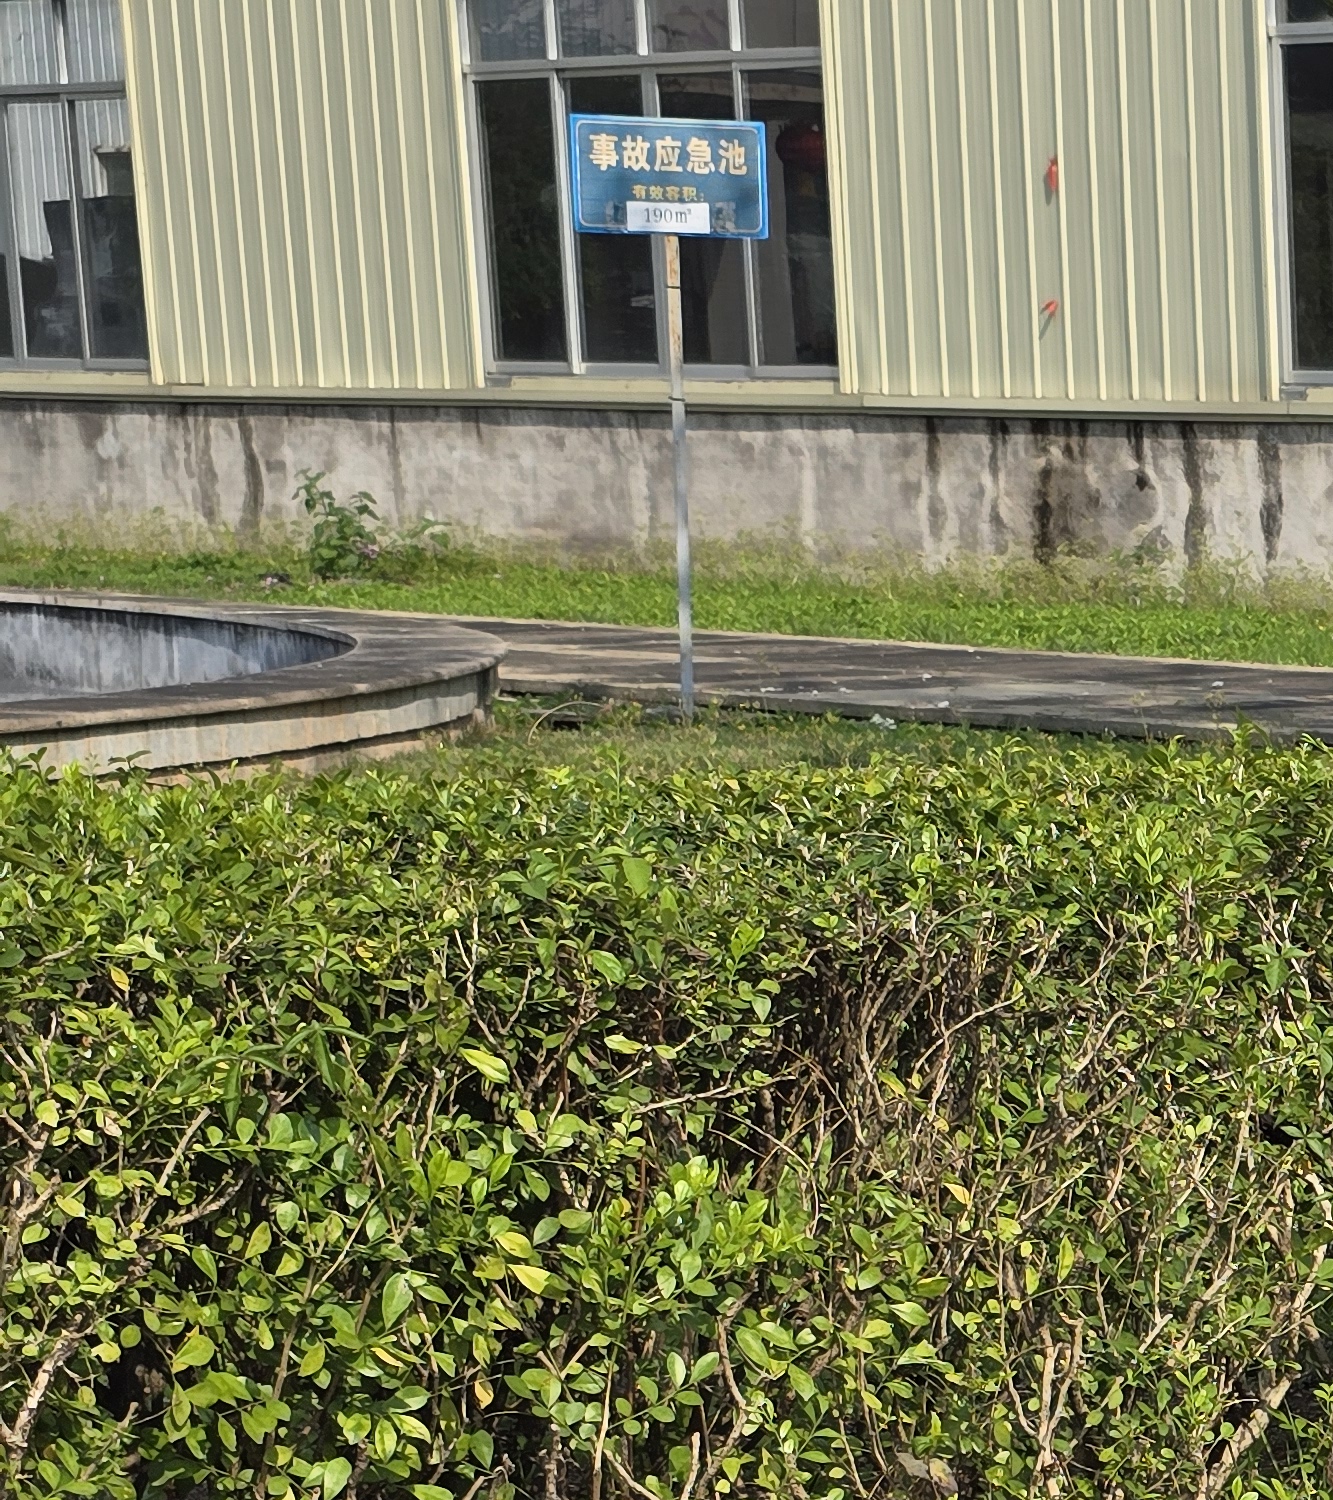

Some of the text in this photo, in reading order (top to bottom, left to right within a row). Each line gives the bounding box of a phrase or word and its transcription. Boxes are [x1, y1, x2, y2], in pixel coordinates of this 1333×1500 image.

[589, 133, 748, 175] 事故应急池
